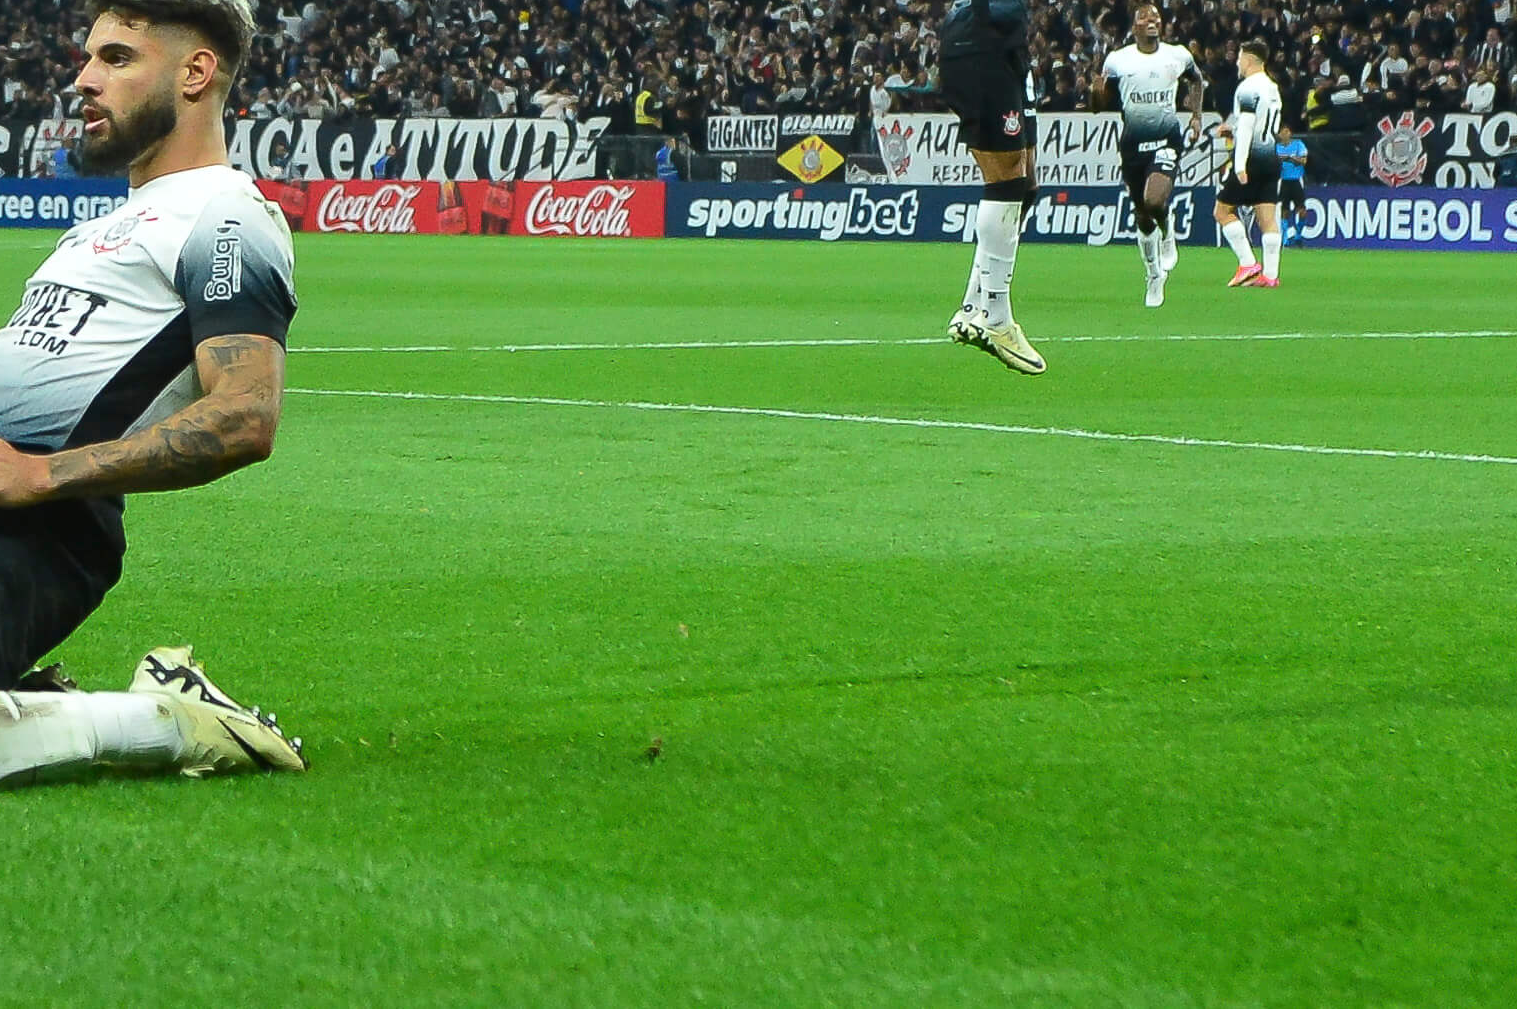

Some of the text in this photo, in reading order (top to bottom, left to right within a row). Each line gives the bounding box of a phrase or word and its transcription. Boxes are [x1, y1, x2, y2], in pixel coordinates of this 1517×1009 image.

[226, 117, 611, 182] ACA e ATITUDE
[709, 115, 776, 150] GIGANTES
[37, 194, 69, 220] en
[316, 183, 418, 234] Coca-Cola
[525, 183, 636, 237] Coca-Cola
[687, 187, 919, 241] sportingbet
[1287, 197, 1493, 243] ONMEBOL
